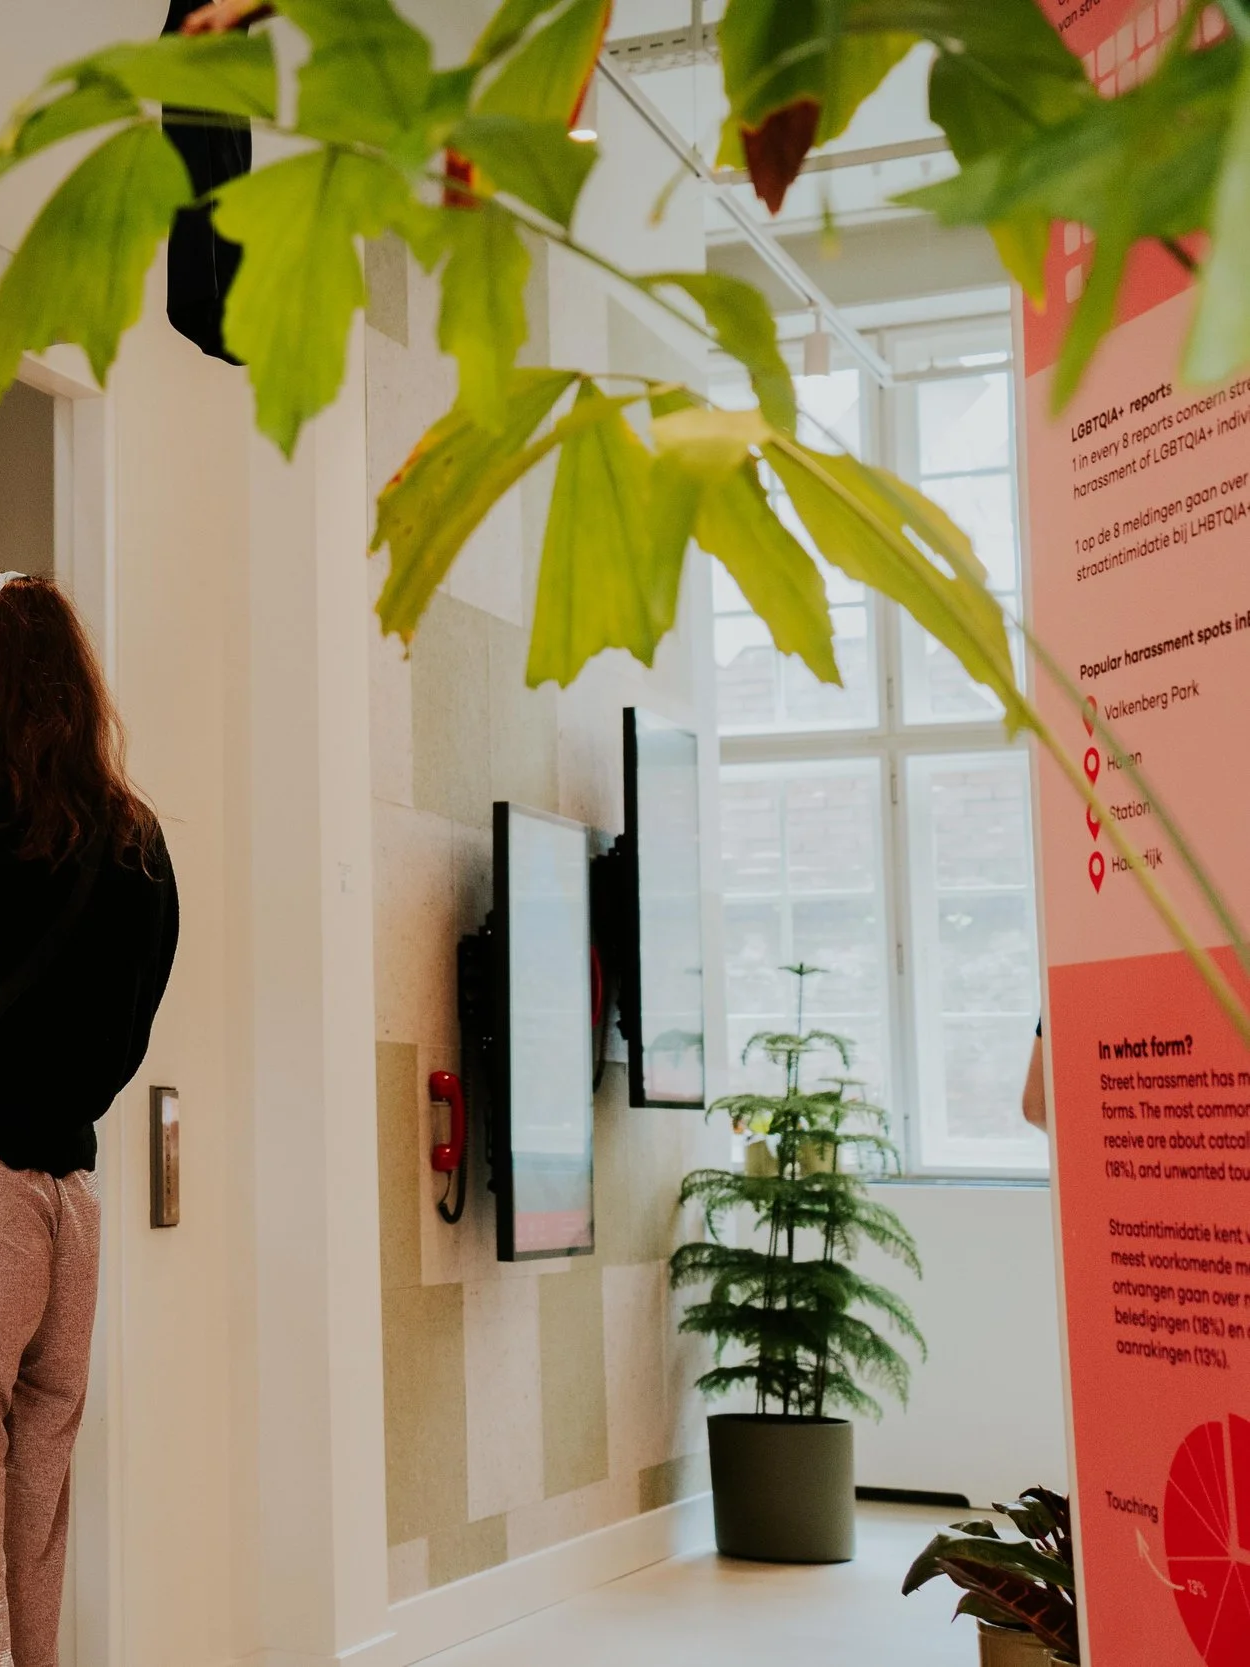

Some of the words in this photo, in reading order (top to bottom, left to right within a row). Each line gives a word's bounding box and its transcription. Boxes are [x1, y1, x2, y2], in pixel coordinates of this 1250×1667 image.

[1071, 406, 1124, 442] LGBTQIA+
[1129, 383, 1172, 414] reports
[1072, 457, 1076, 471] 1
[1078, 454, 1088, 469] in
[1090, 440, 1120, 464] every
[1122, 431, 1129, 449] 8
[1131, 414, 1173, 444] reports
[1175, 389, 1226, 424] concern
[1073, 458, 1137, 498] harassment
[1139, 448, 1151, 470] of
[1153, 426, 1213, 464] LGBTQIA+
[1075, 539, 1079, 553] 1
[1081, 535, 1095, 552] op
[1097, 527, 1111, 545] de
[1113, 521, 1120, 538] 8
[1122, 499, 1182, 534] meldingen
[1185, 485, 1217, 513] gaan
[1220, 472, 1248, 495] over
[1076, 534, 1170, 582] straatintimidatie
[1172, 528, 1187, 544] bij
[1079, 655, 1122, 680] Popular
[1124, 629, 1194, 665] harassment
[1196, 619, 1232, 644] spots
[1104, 692, 1168, 720] Valkenberg
[1170, 679, 1199, 702] Park
[1107, 751, 1142, 770] Haen
[1110, 801, 1150, 821] Station
[1111, 848, 1163, 872] Hadijk
[1098, 1040, 1111, 1059] In
[1113, 1038, 1148, 1058] what
[1149, 1034, 1193, 1057] form?
[1100, 1073, 1135, 1090] Street
[1136, 1071, 1209, 1089] harassment
[1210, 1069, 1235, 1087] has
[1101, 1101, 1137, 1120] forms.
[1138, 1100, 1161, 1119] The
[1162, 1101, 1194, 1119] most
[1103, 1134, 1144, 1149] receive
[1146, 1134, 1166, 1149] are
[1168, 1131, 1206, 1149] about
[1105, 1159, 1136, 1180] (18%),
[1138, 1161, 1161, 1179] and
[1163, 1162, 1226, 1180] unwanted
[1108, 1218, 1211, 1242] Straatintimidatie
[1213, 1224, 1243, 1245] kent
[1110, 1250, 1146, 1267] meest
[1147, 1252, 1232, 1275] voorkomende
[1112, 1279, 1175, 1303] ontvangen
[1176, 1286, 1210, 1306] gaan
[1211, 1290, 1241, 1307] over
[1114, 1305, 1190, 1335] beledigingen
[1192, 1314, 1225, 1337] (18%)
[1227, 1323, 1245, 1339] en
[1115, 1339, 1191, 1366] aanrakingen
[1193, 1345, 1229, 1369] (13%).
[1104, 1490, 1158, 1524] Touching
[1186, 1578, 1207, 1598] 13%
